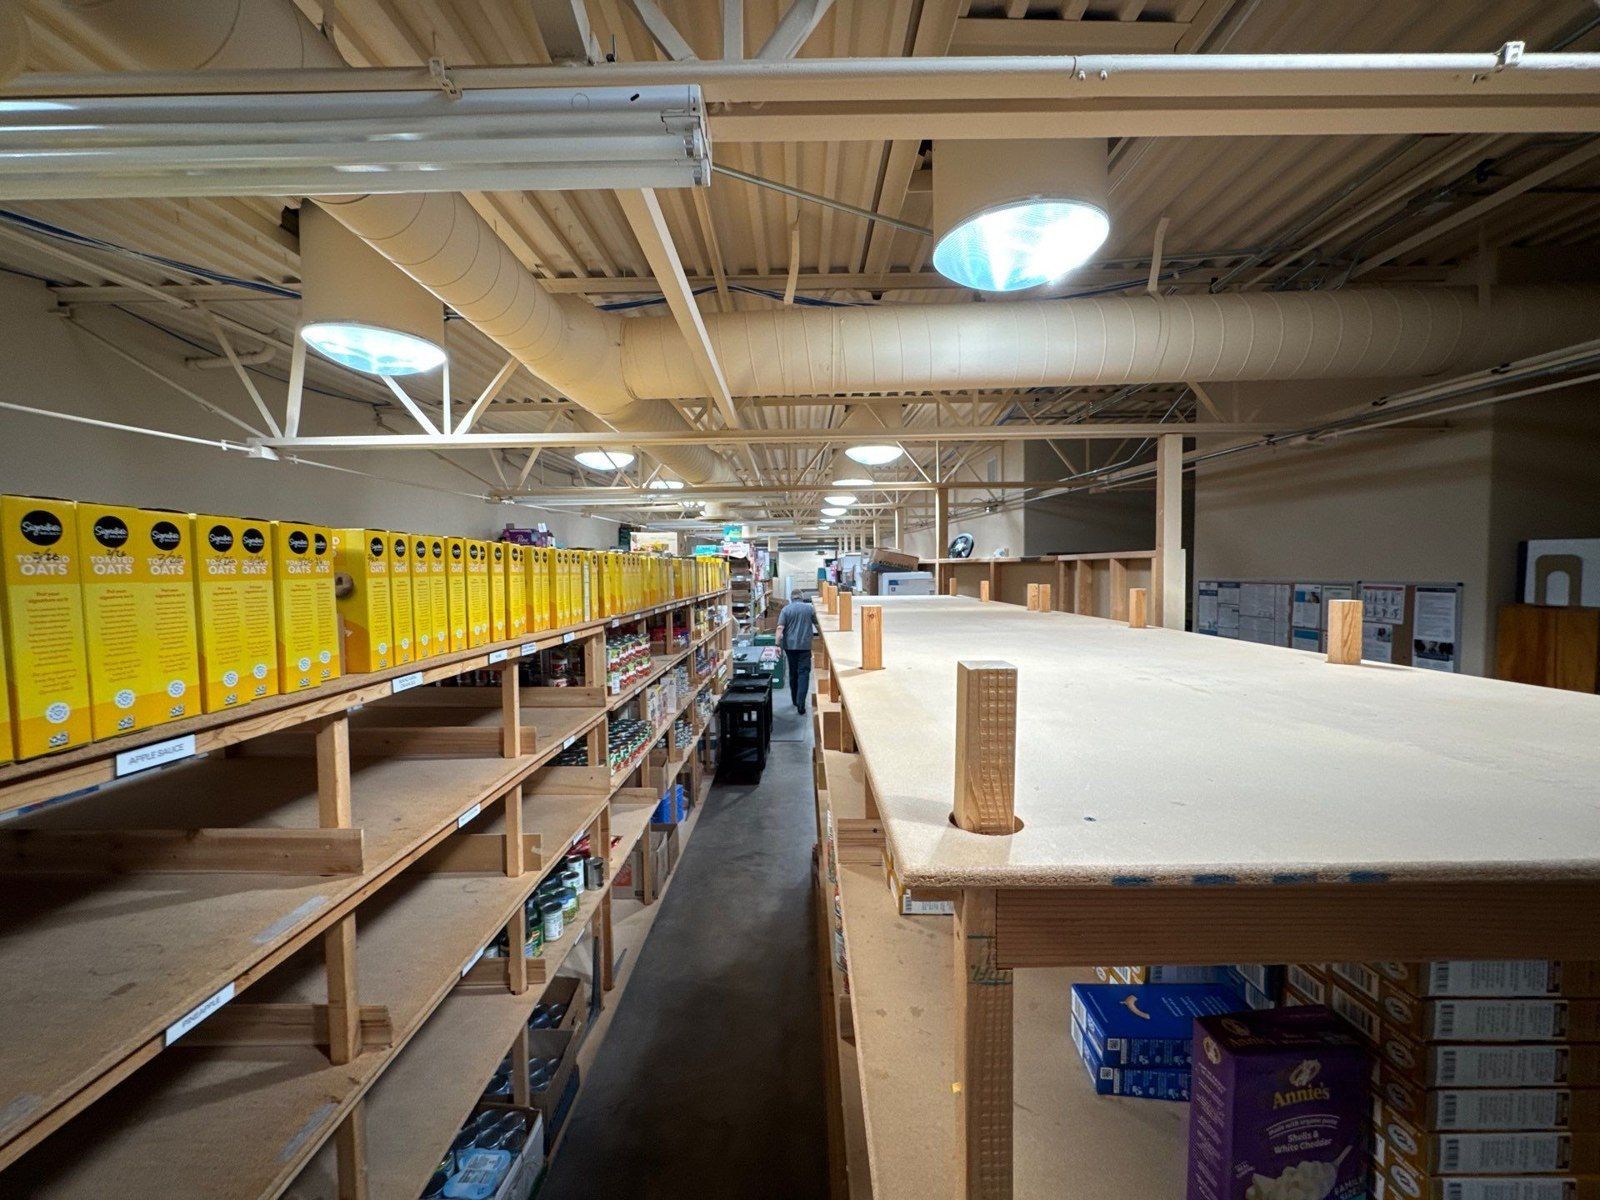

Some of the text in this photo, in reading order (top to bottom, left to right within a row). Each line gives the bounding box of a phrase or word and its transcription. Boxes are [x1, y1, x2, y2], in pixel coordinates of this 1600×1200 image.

[90, 555, 135, 564] TOASTED
[20, 563, 68, 576] OATS
[93, 564, 133, 575] OATS
[150, 565, 184, 575] OATS
[208, 565, 237, 575] OATS
[242, 566, 267, 574] OATS
[288, 566, 312, 574] OATS
[128, 743, 184, 766] APPLE SAUCE
[1273, 1081, 1330, 1110] Annie's
